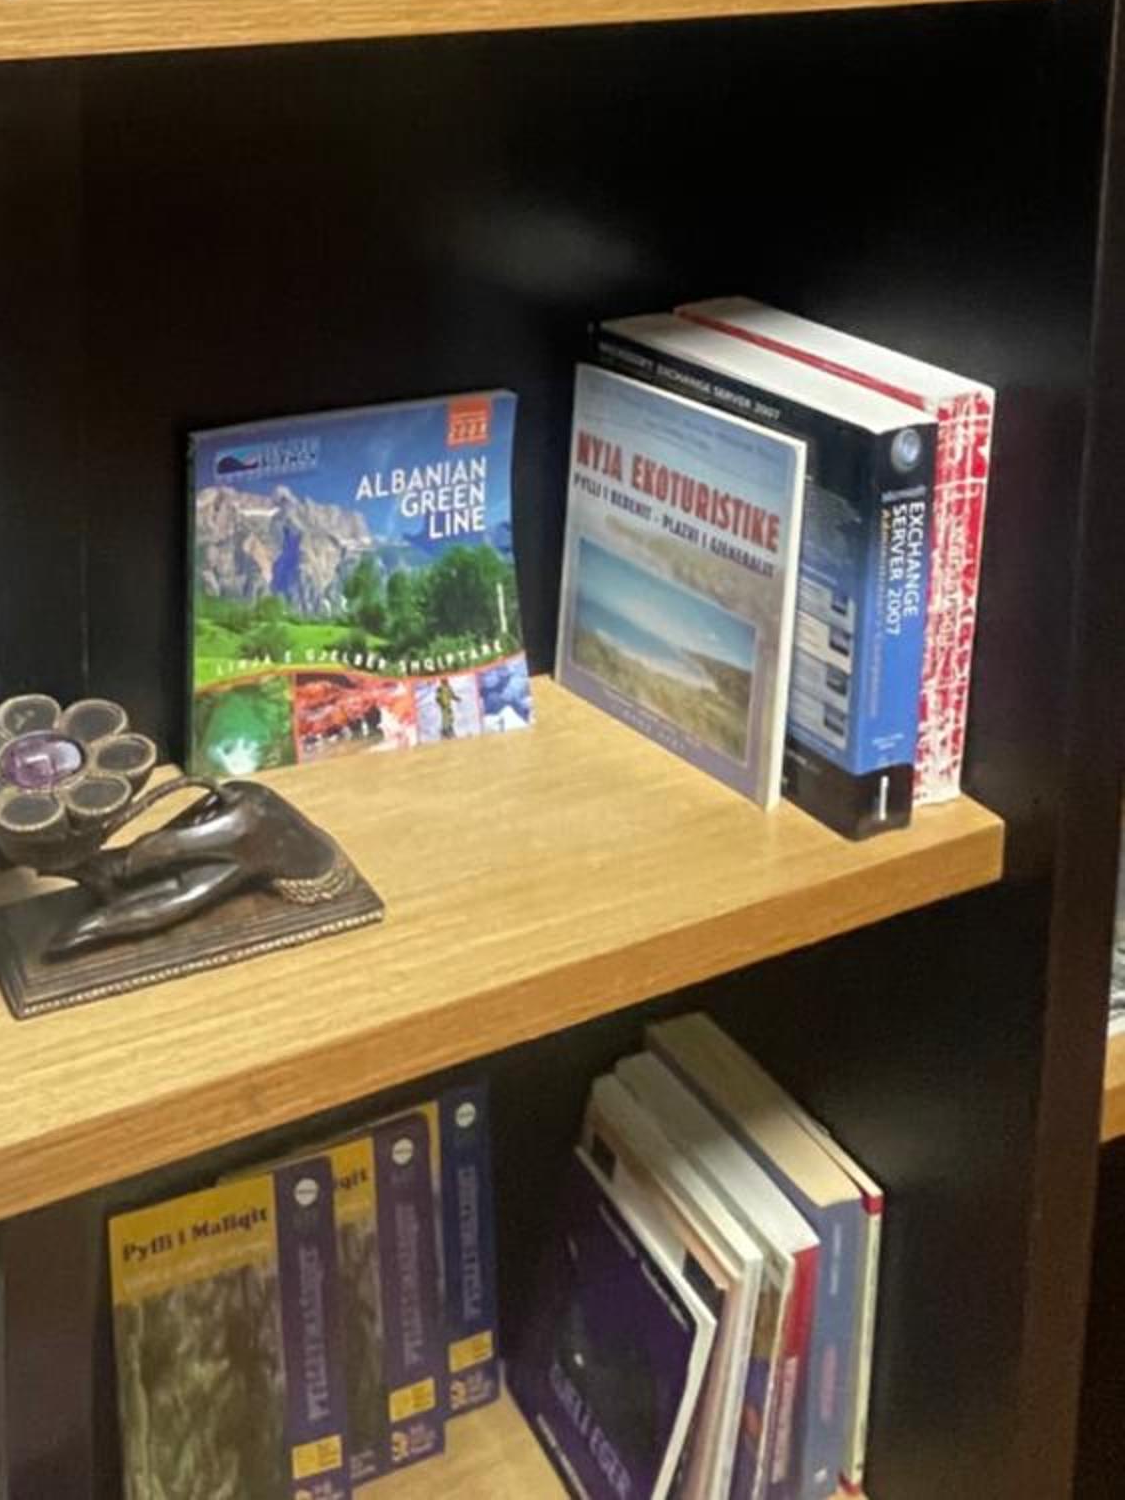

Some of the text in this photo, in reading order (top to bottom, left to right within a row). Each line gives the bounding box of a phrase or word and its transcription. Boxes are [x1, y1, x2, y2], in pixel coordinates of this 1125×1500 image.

[355, 456, 487, 501] ALBANIAN
[401, 483, 486, 518] GREEN
[632, 458, 780, 553] EKOTURISTIKE
[429, 506, 486, 539] LINE
[885, 505, 909, 636] SERVER 2007
[903, 501, 925, 617] EXCHANGE
